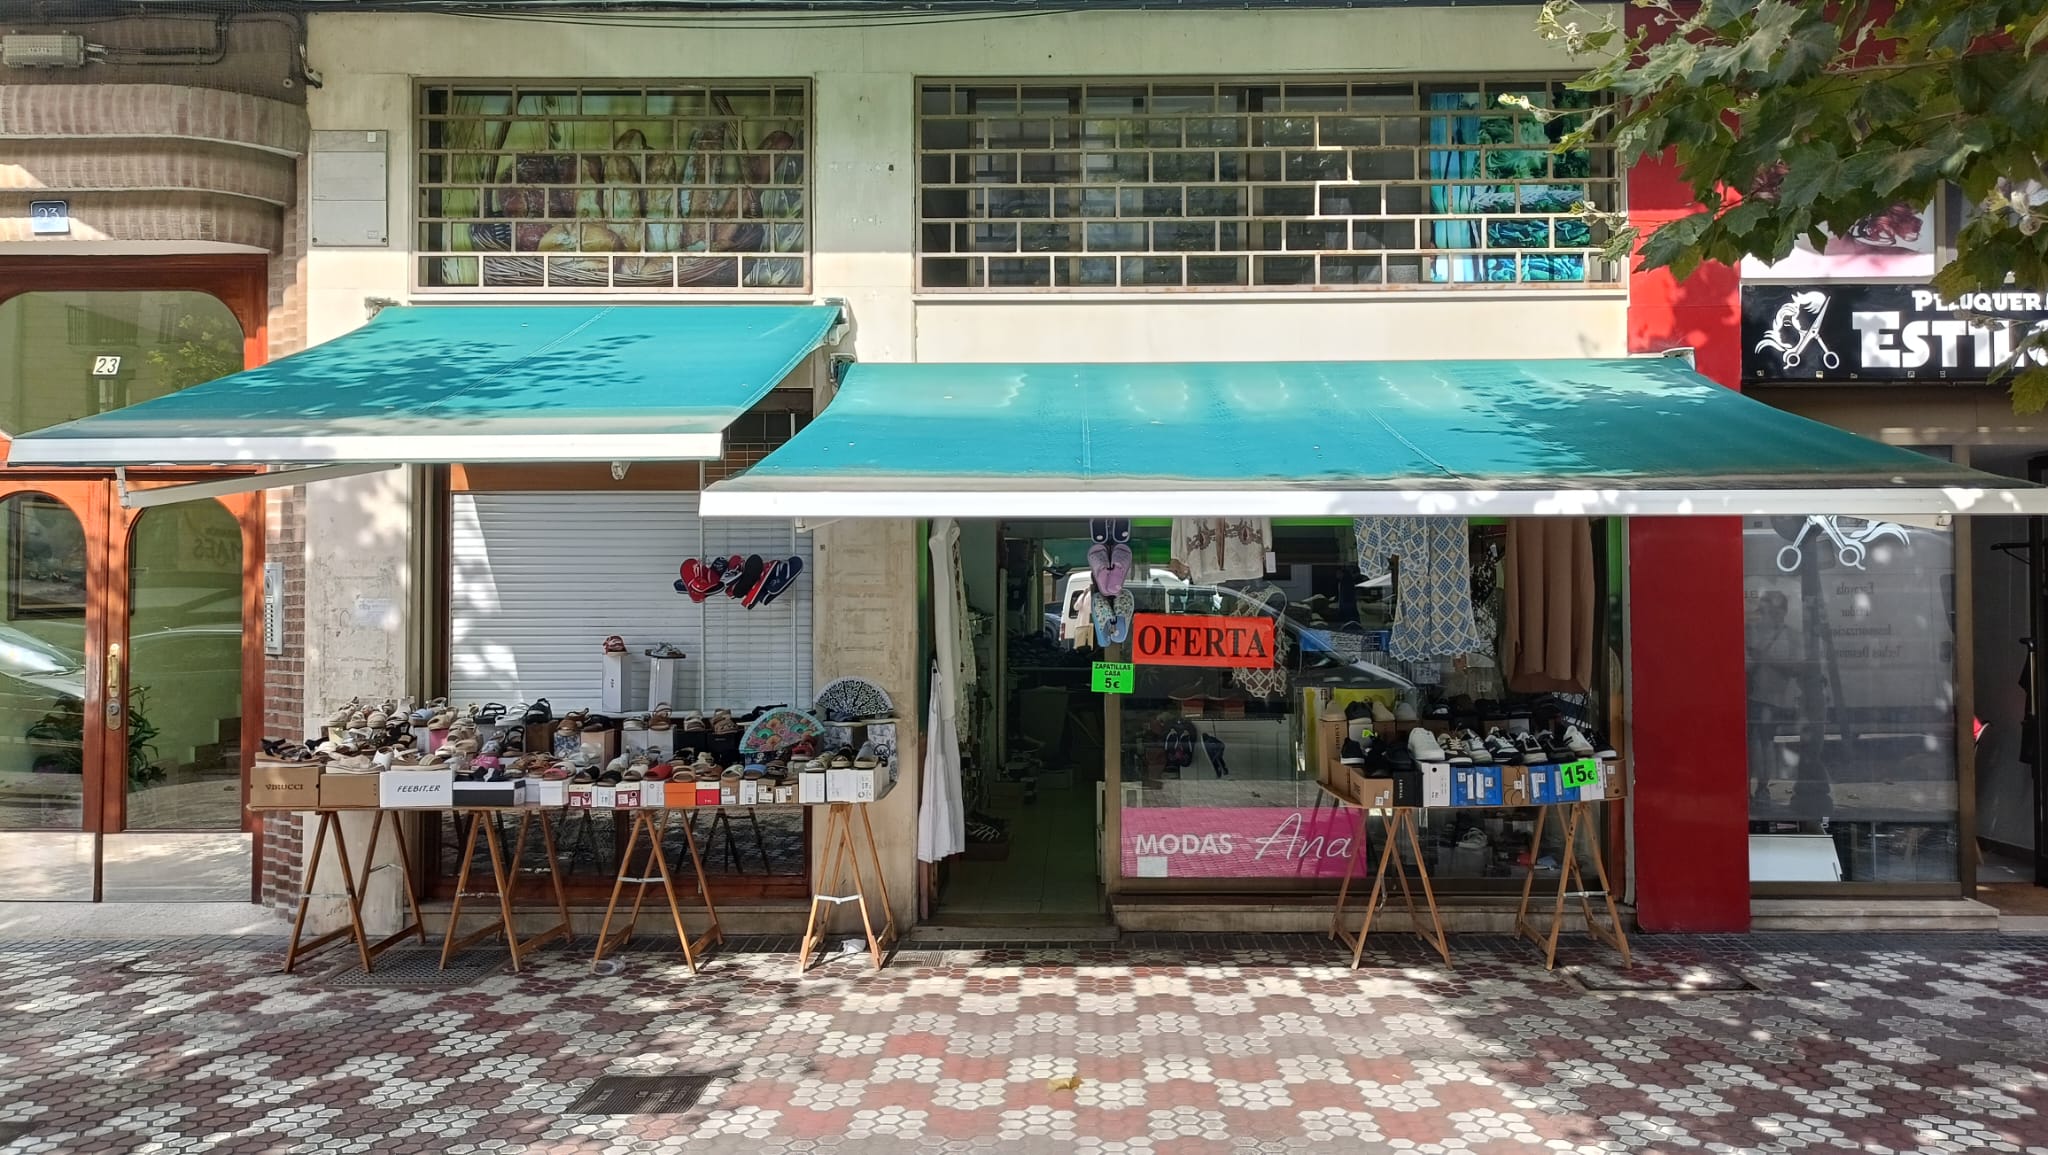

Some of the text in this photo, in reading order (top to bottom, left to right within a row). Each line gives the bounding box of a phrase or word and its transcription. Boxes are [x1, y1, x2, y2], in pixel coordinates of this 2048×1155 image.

[1911, 289, 2048, 312] PEUQUER
[95, 357, 118, 374] 23
[1137, 624, 1268, 659] OFERTA
[1095, 663, 1131, 671] ZAPATILLAS
[1104, 677, 1121, 689] 5€
[1563, 764, 1595, 785] 15€
[1134, 812, 1353, 861] MODAS Ana
